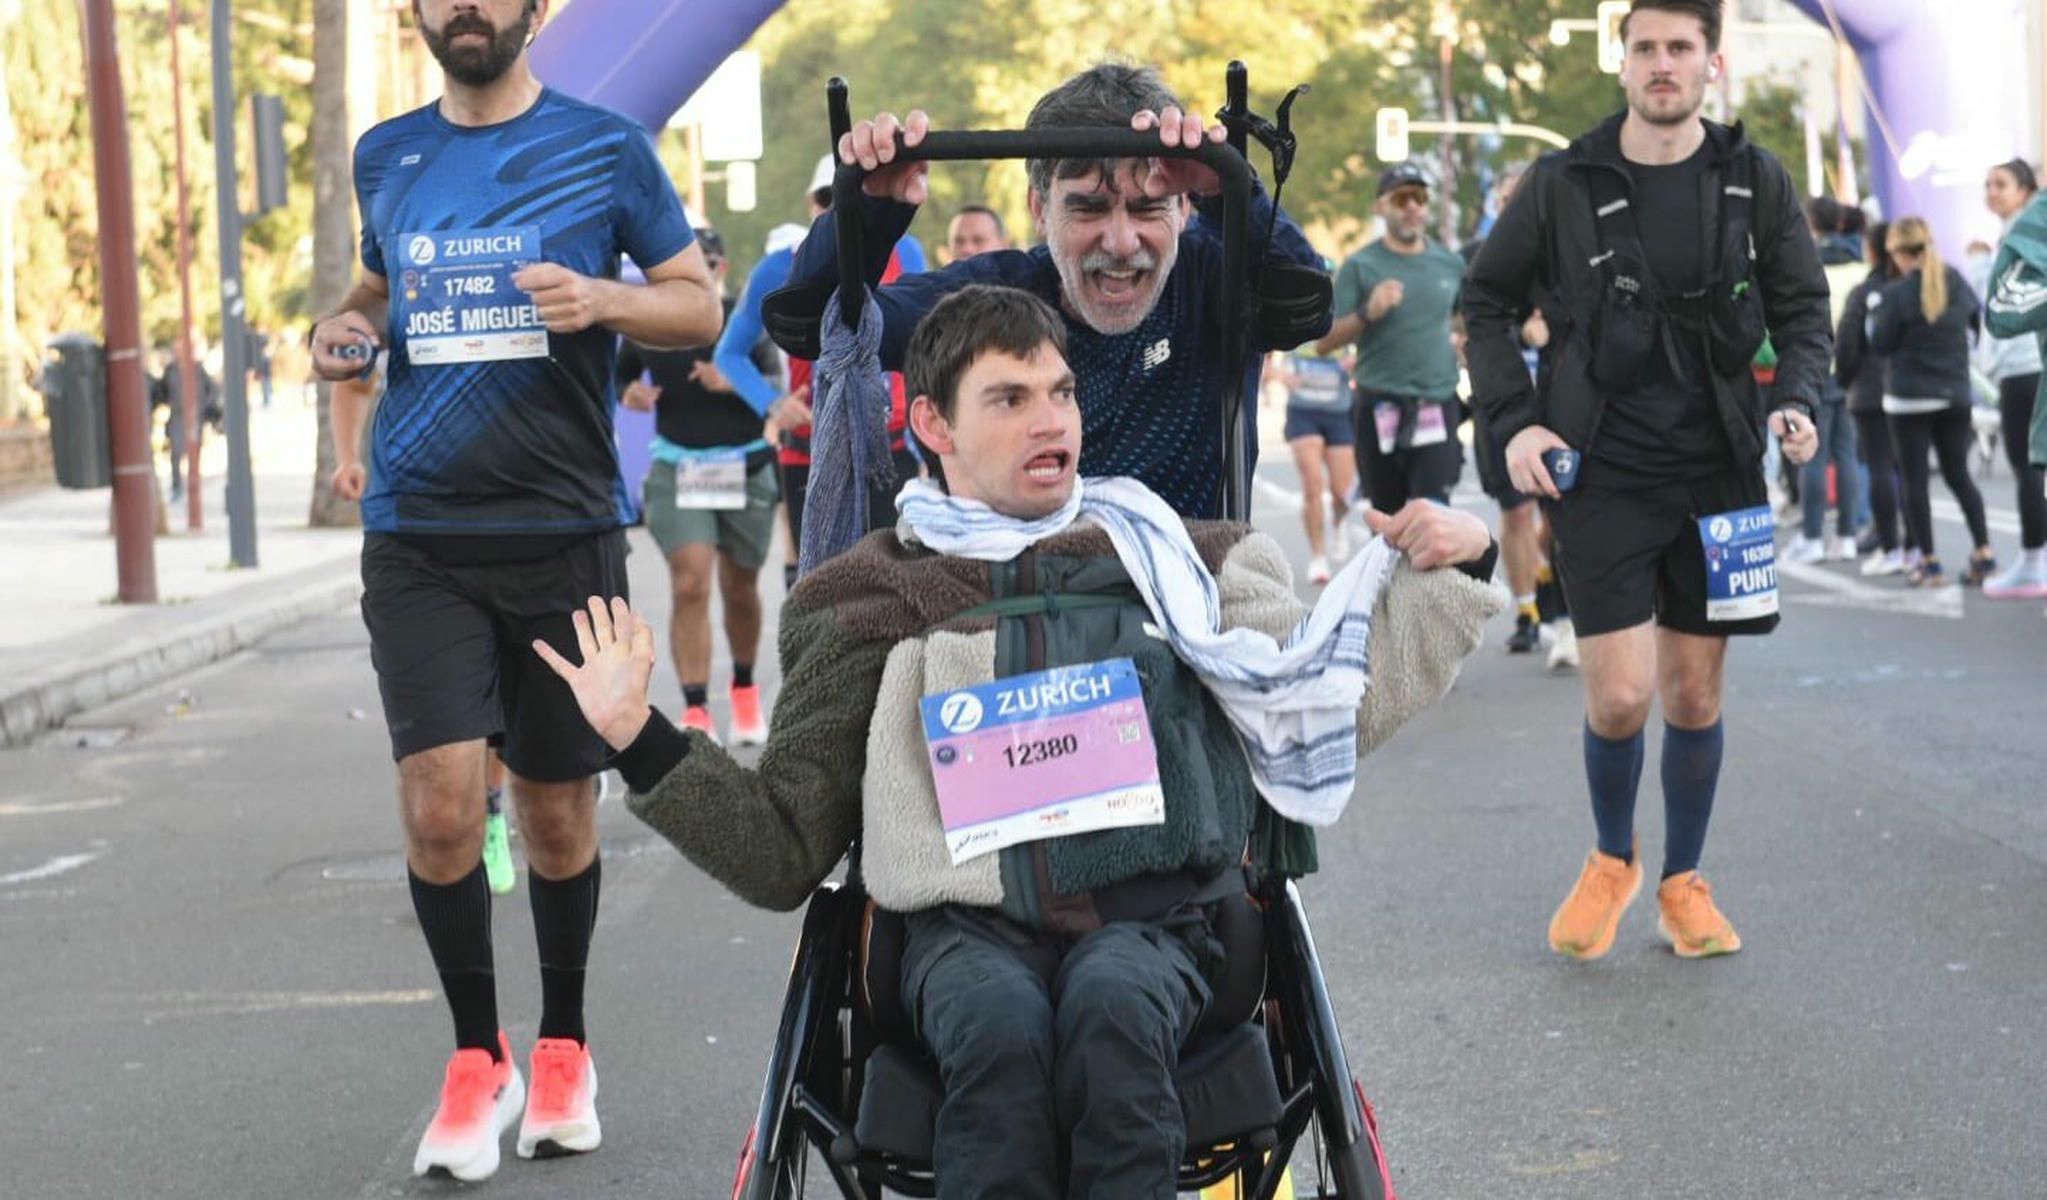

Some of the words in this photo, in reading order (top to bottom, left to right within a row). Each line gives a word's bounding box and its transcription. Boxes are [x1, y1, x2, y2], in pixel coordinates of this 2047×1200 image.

[443, 235, 522, 257] ZURICH
[444, 275, 496, 297] 17482
[405, 305, 456, 336] JOSÉ
[461, 305, 547, 331] MIGUEL
[996, 675, 1111, 716] ZURICH
[1003, 733, 1078, 769] 12380
